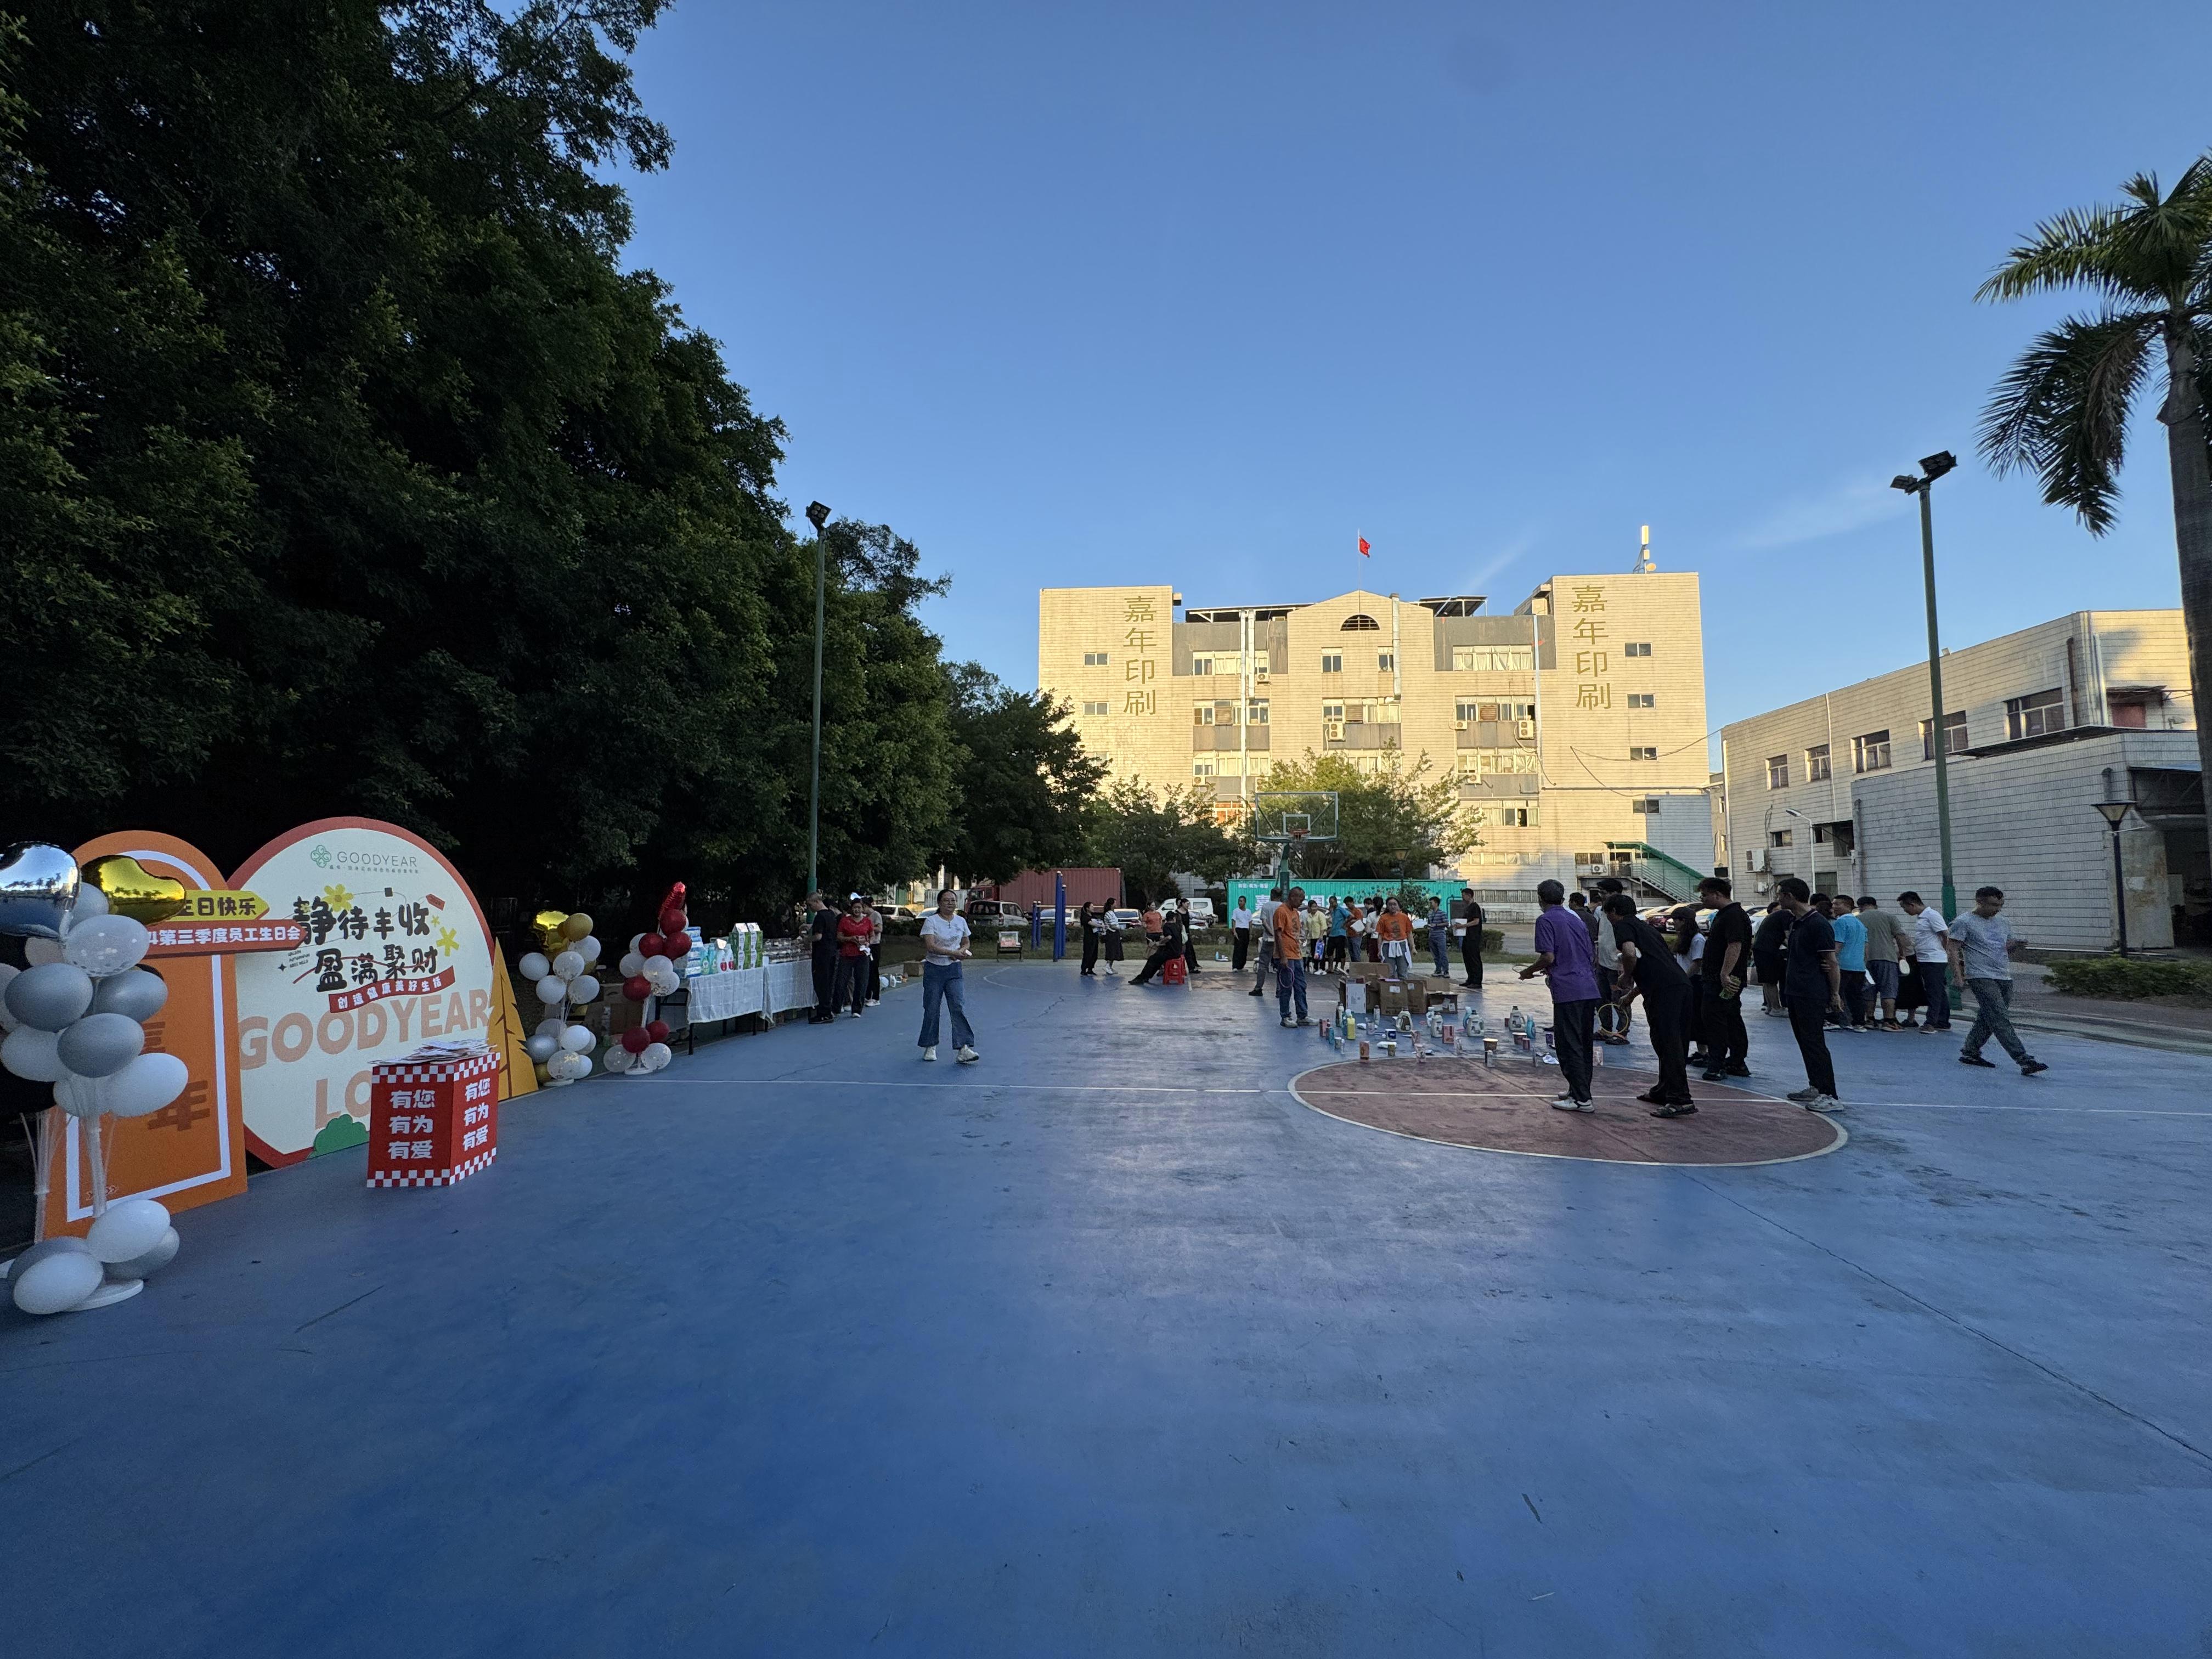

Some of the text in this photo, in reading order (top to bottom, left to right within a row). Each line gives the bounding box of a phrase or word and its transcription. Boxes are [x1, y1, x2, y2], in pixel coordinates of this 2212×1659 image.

[1123, 596, 1157, 716] 嘉年印刷
[1572, 585, 1612, 710] 嘉年印刷
[337, 851, 417, 867] GOODYEAR
[293, 895, 430, 945] 静待丰收
[314, 944, 438, 992] 盈满聚财
[337, 977, 442, 1010] 创造健康美好生活
[239, 989, 489, 1070] GOODYEAR
[390, 1089, 436, 1109] 有您
[465, 1077, 491, 1102] 有您
[388, 1114, 434, 1135] 有为
[463, 1102, 489, 1127] 有为
[387, 1139, 433, 1160] 有爱
[462, 1124, 489, 1152] 有爱
